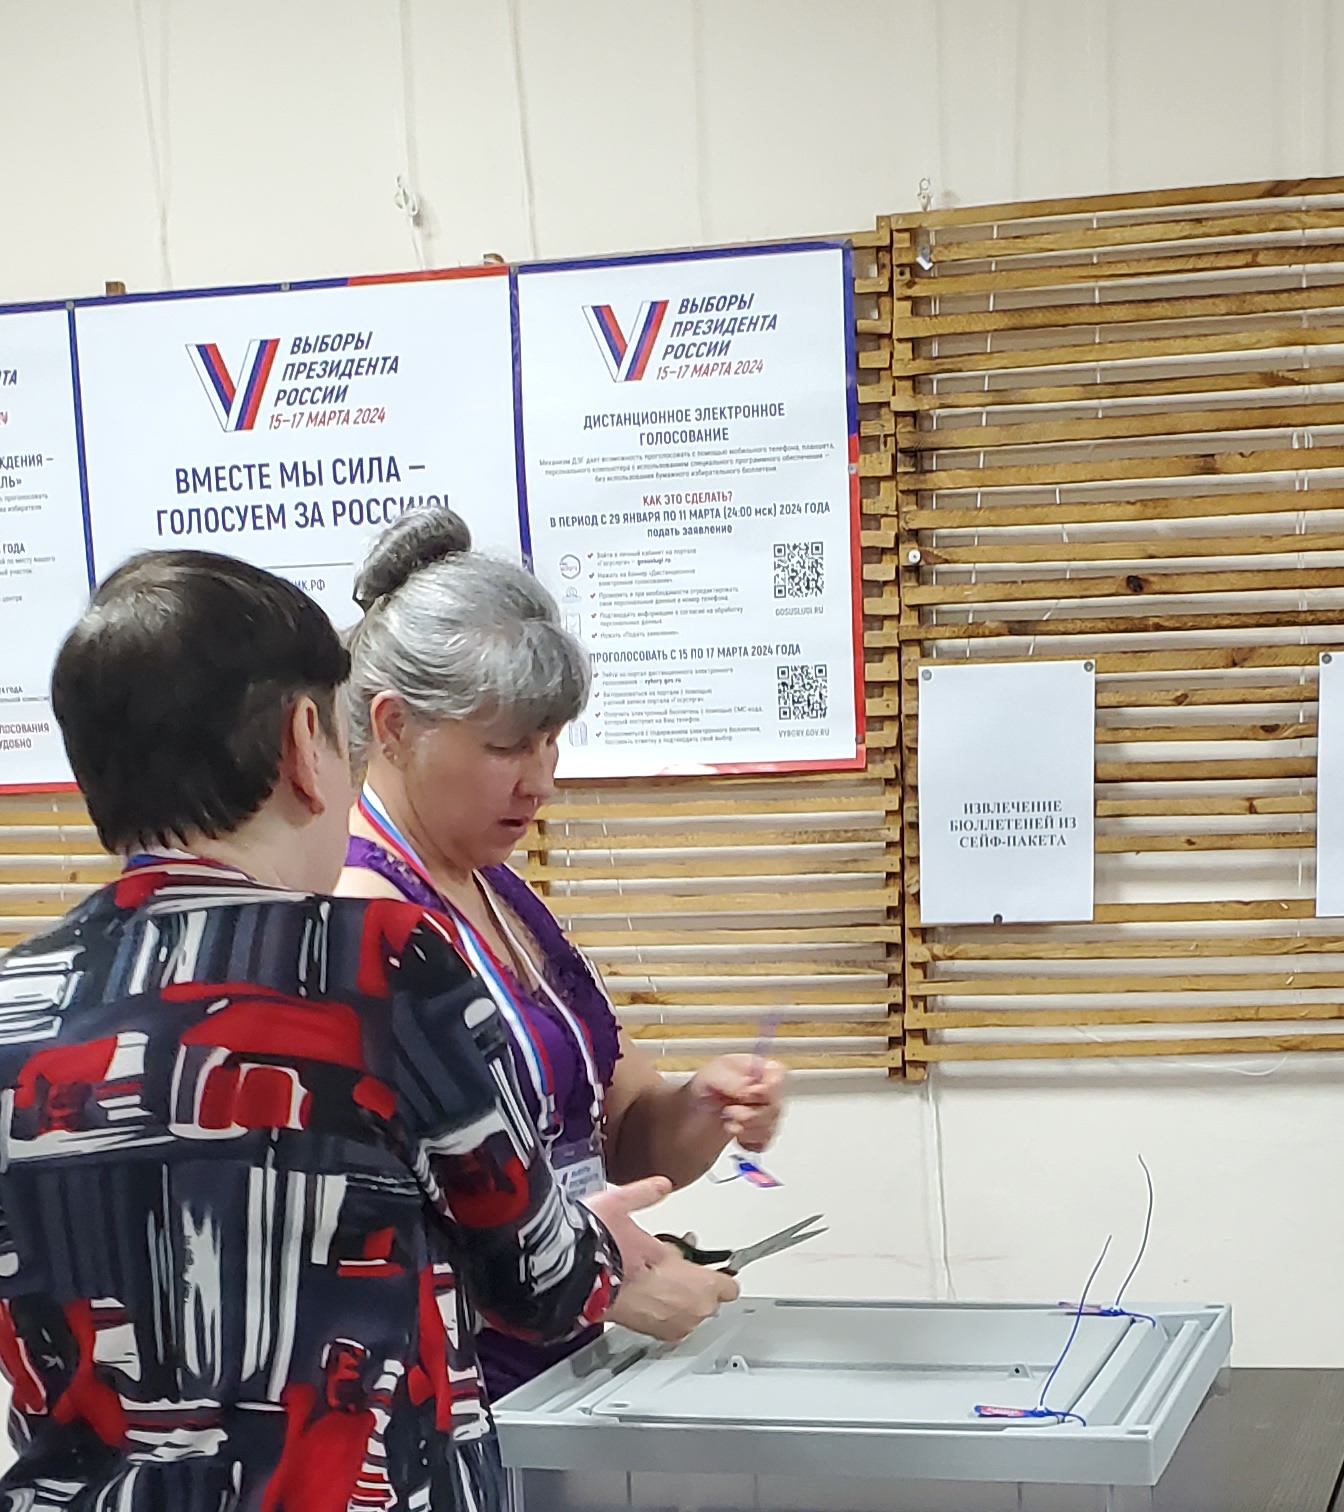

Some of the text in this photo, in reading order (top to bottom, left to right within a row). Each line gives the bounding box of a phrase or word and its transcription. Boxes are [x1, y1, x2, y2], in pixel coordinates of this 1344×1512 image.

[677, 293, 755, 314] ВЫБОРЫ
[669, 314, 778, 337] ПРЕЗИДЕНТА
[289, 331, 373, 354] ВЫБОРЫ
[661, 340, 732, 360] РОССИИ
[281, 356, 399, 380] ПРЕЗИДЕНТА
[690, 361, 732, 378] МАРТА
[733, 359, 764, 375] 2024
[273, 385, 349, 406] РОССИИ
[305, 409, 350, 427] МАРТА
[352, 407, 386, 424] 2024
[583, 402, 785, 429] ДИСТАНЦИОННОЕ ЭЛЕКТРОННОЕ
[639, 427, 729, 445] ГОЛОСОВАНИЕ
[175, 463, 272, 493] ВМЕСТЕ
[279, 460, 324, 488] МЫ
[331, 456, 401, 485] СИЛА
[642, 490, 733, 506] КАК ЭТО СДЕЛАТЬ?
[156, 504, 286, 534] ГОЛОСУЕМ
[293, 501, 325, 528] ЗА
[549, 501, 830, 528] В ПЕРИОД С 29 ЯНВАРЯ ПО 11 МАРТА (24:00 мск) 2024 ГОДА
[646, 524, 733, 538] подать заявление
[590, 643, 801, 664] ПРОГОЛОСОВАТЬ С 15 ПО 17 МАРТА 2024 ГОДА
[963, 800, 1062, 814] ИЗВЛЕЧЕНИЕ
[950, 815, 1076, 831] БЮЛЛЕТЕНЕЙ ИЗ
[959, 834, 1066, 848] СЕЙФ-ПАКЕТА
